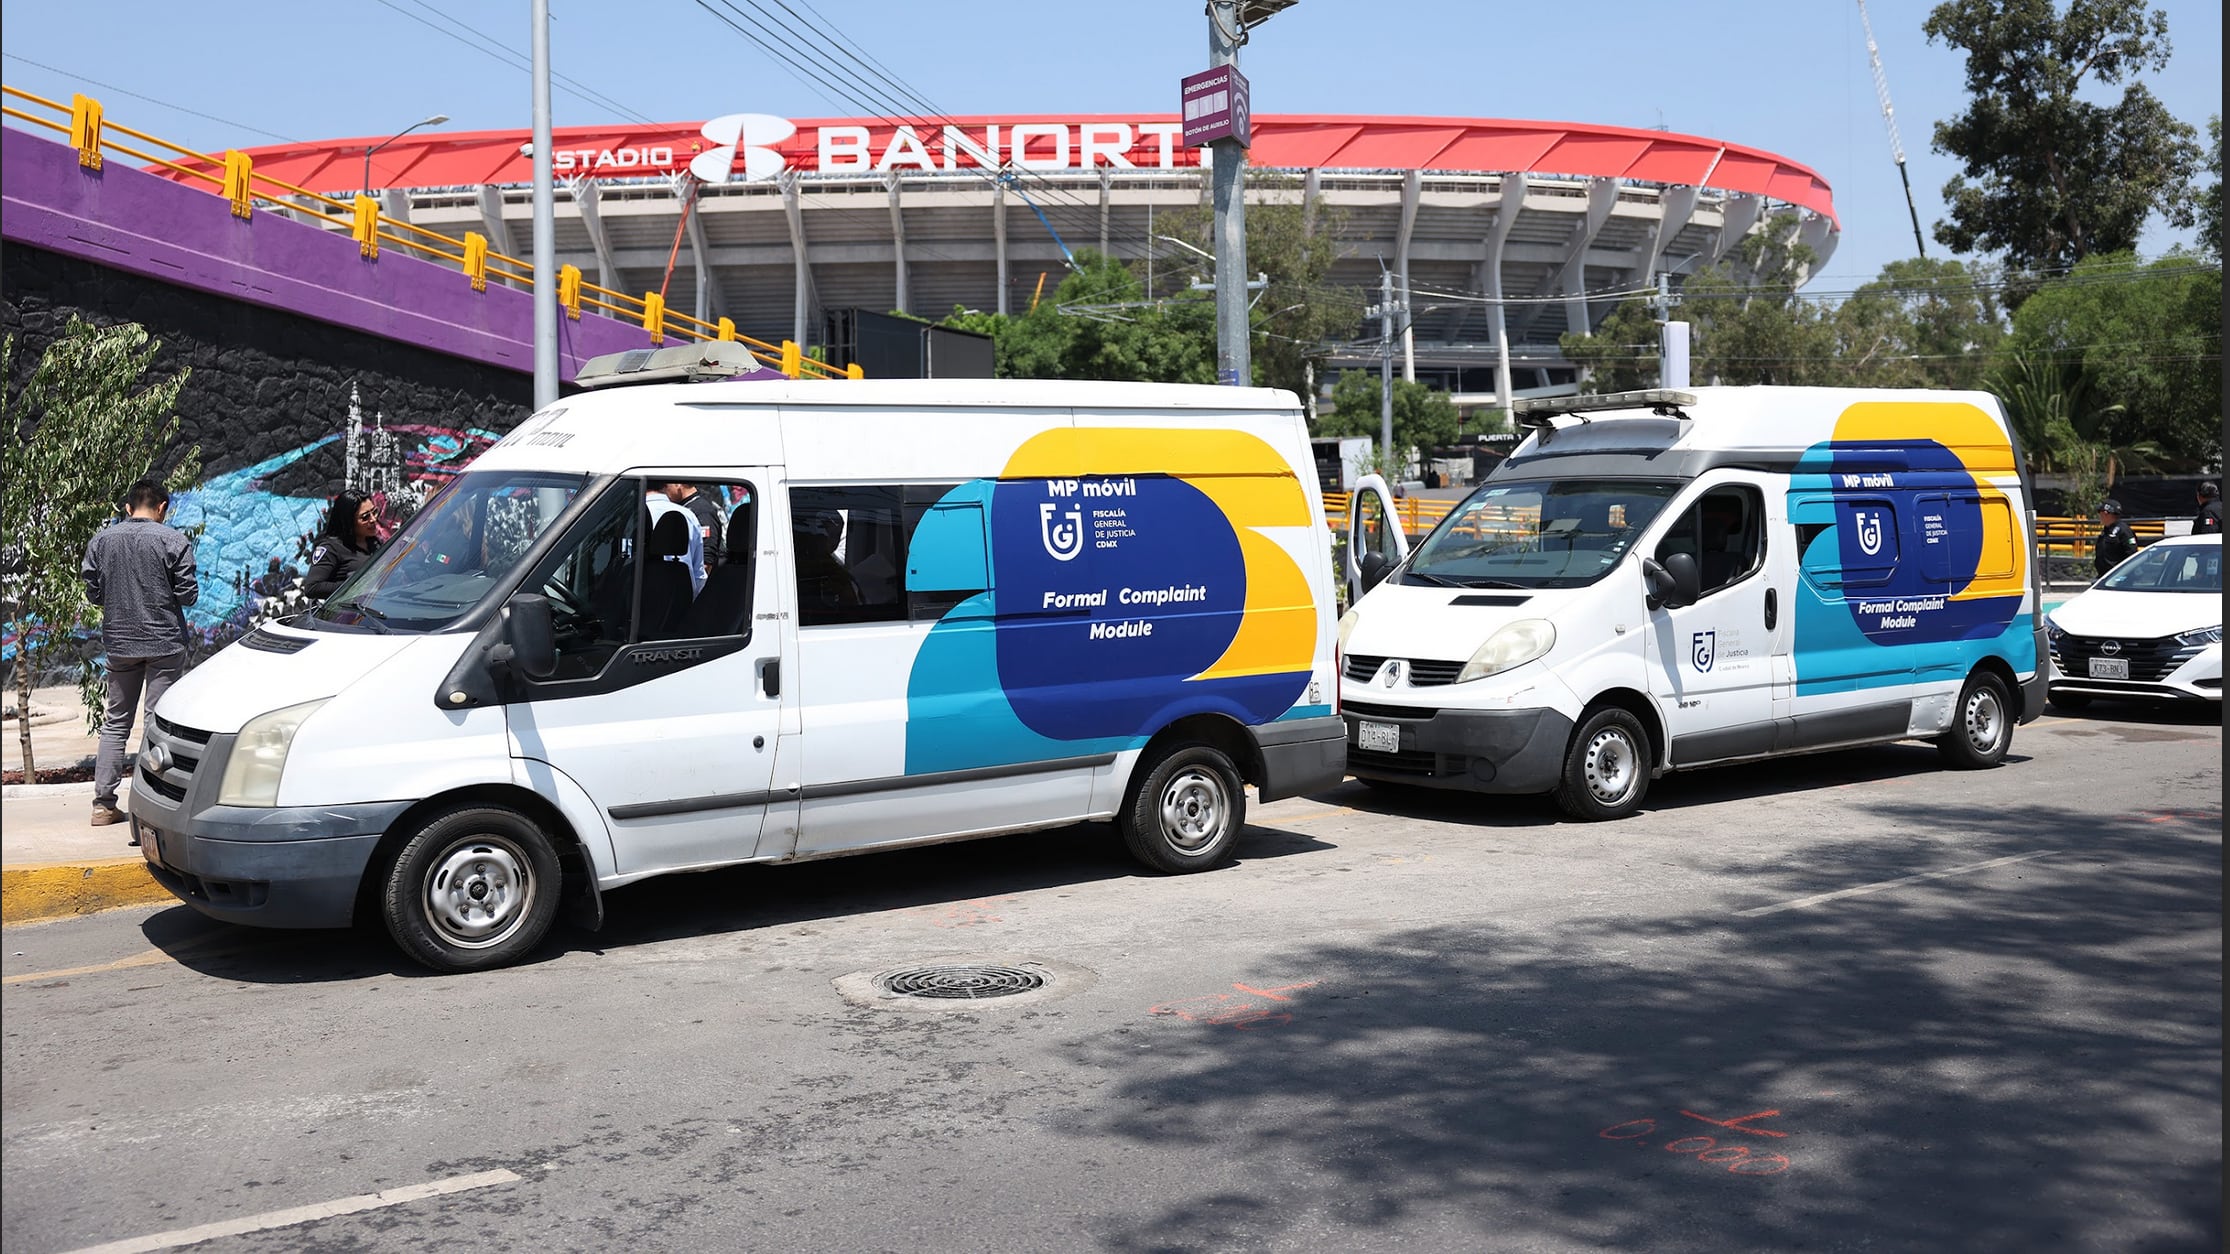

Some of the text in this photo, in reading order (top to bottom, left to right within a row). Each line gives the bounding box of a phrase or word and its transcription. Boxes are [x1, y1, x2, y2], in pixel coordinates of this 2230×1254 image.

[1184, 74, 1228, 95] EMERGENCIAS
[1185, 127, 1201, 137] BOTÓN
[1210, 119, 1229, 129] AUXILIO
[552, 124, 1213, 173] STADIO BANORT
[1478, 434, 1514, 442] PUERTA
[1047, 477, 1136, 497] MP móvil
[1842, 473, 1894, 488] MP móvil
[1093, 508, 1126, 518] FISCALÍA
[1094, 520, 1126, 528] GENERAL
[1095, 529, 1136, 539] DE JUSTICIA
[1096, 540, 1117, 548] CDMX
[1043, 584, 1207, 609] Formal Complaint
[1858, 598, 1944, 614] Formal Complaint
[1089, 620, 1153, 640] Module
[1880, 615, 1916, 629] Module
[632, 648, 702, 664] TRANSIT
